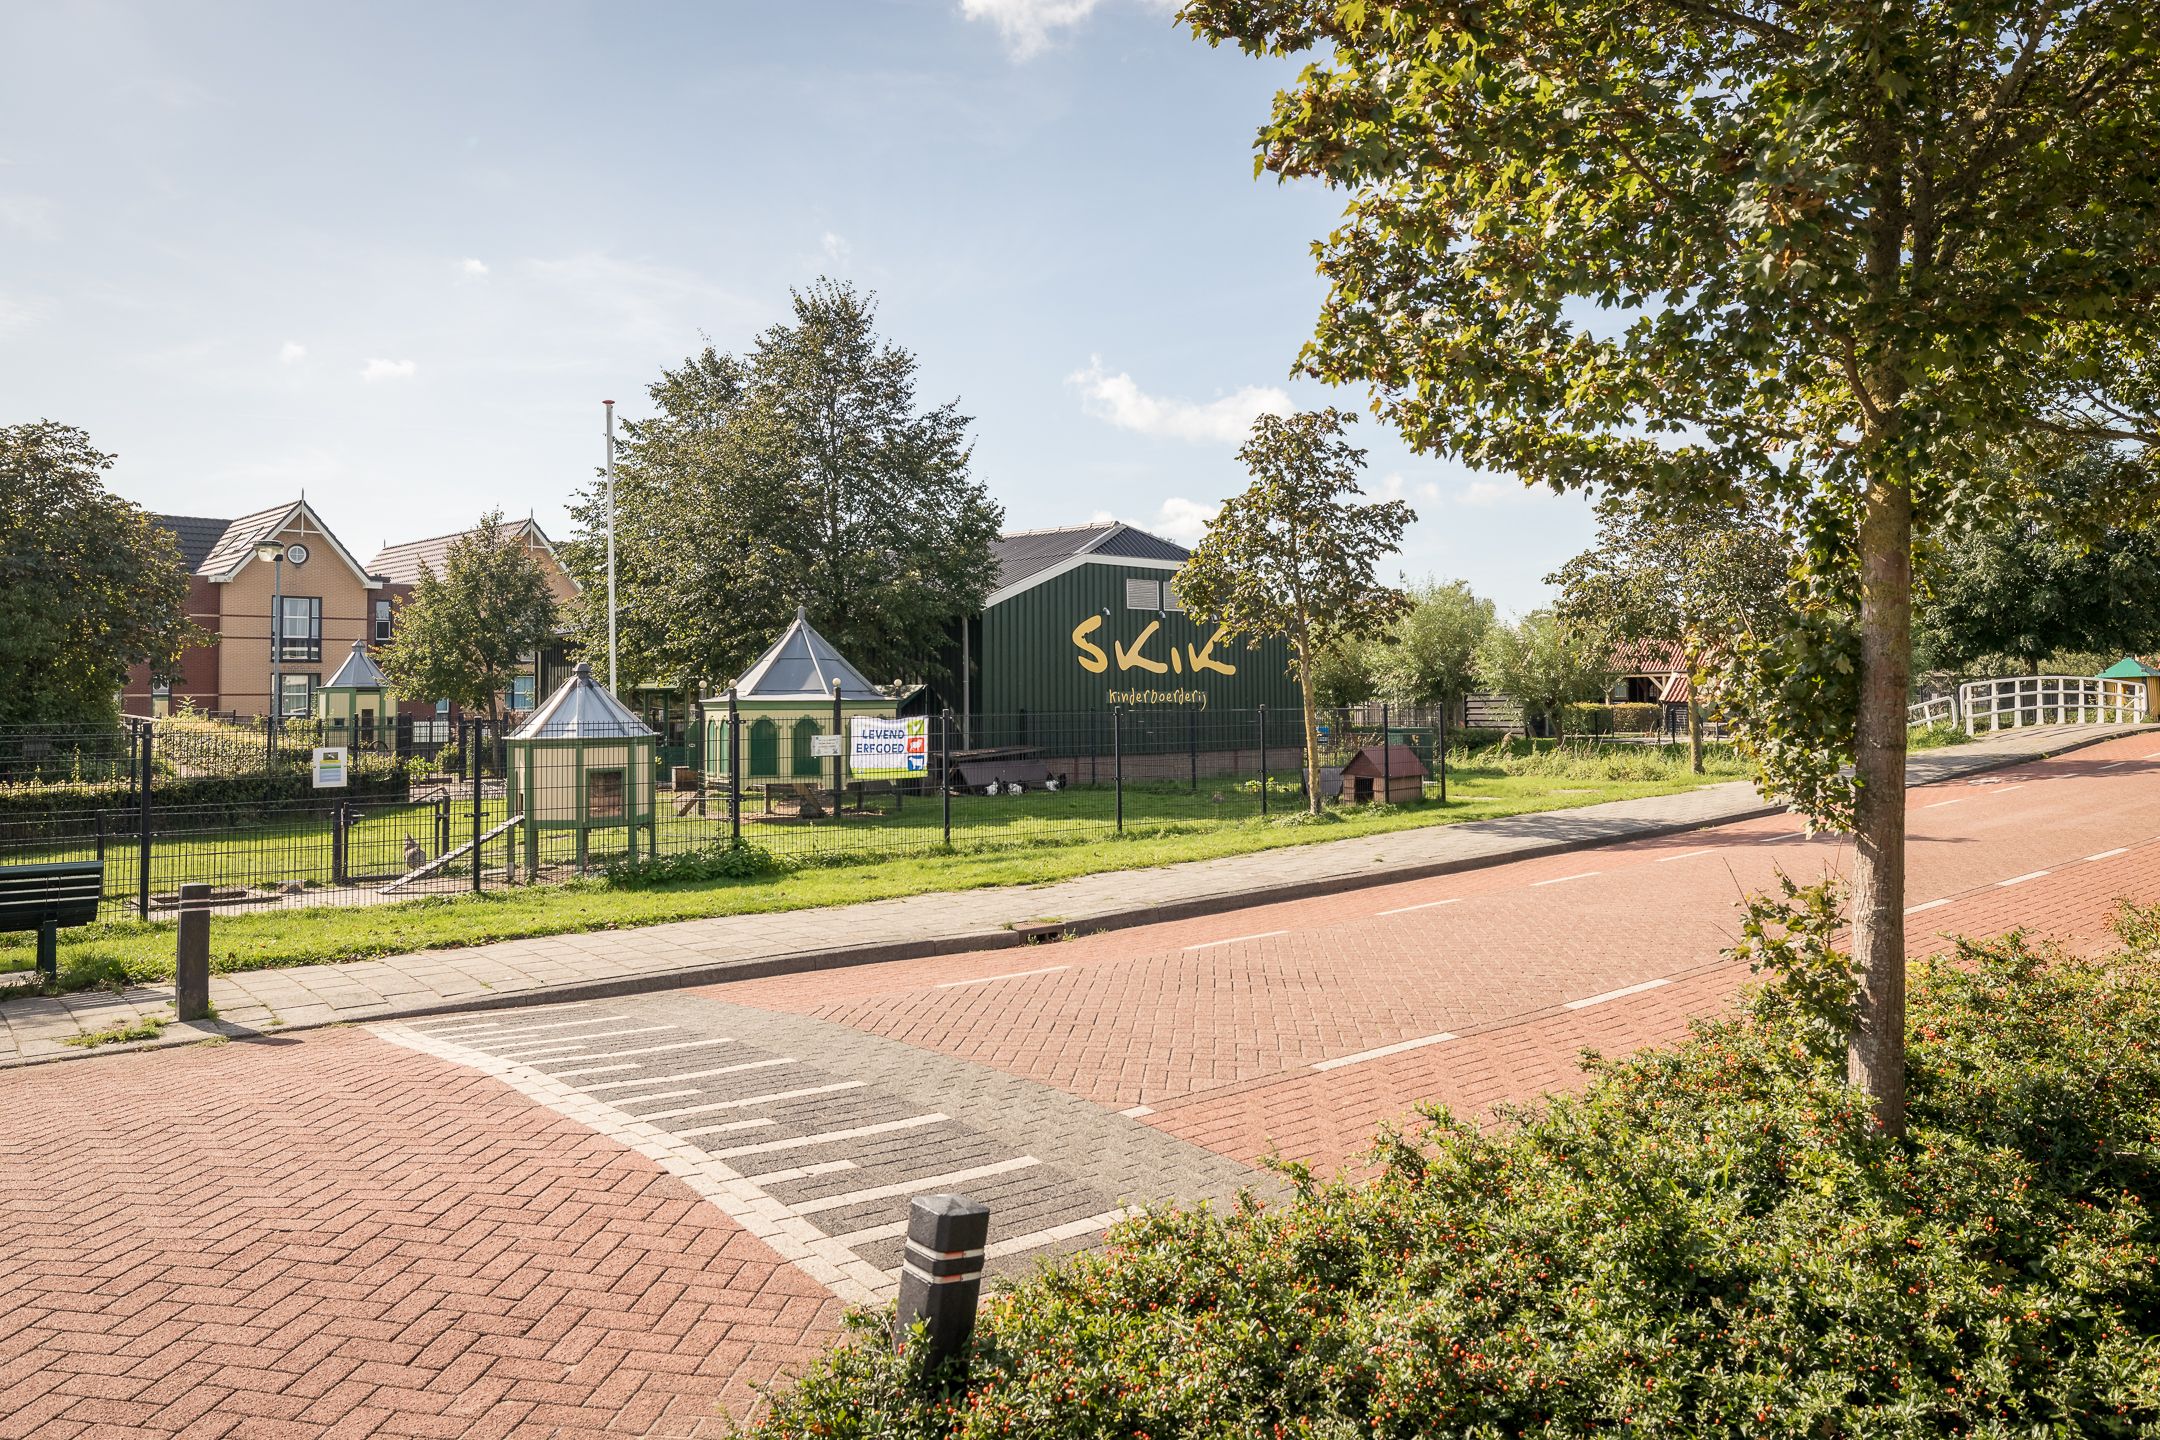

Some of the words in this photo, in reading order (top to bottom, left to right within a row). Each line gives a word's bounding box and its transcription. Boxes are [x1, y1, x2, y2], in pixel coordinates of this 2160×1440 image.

[1072, 615, 1236, 676] SKIK
[862, 729, 905, 740] LEVEND
[856, 743, 905, 753] ERFGOED
